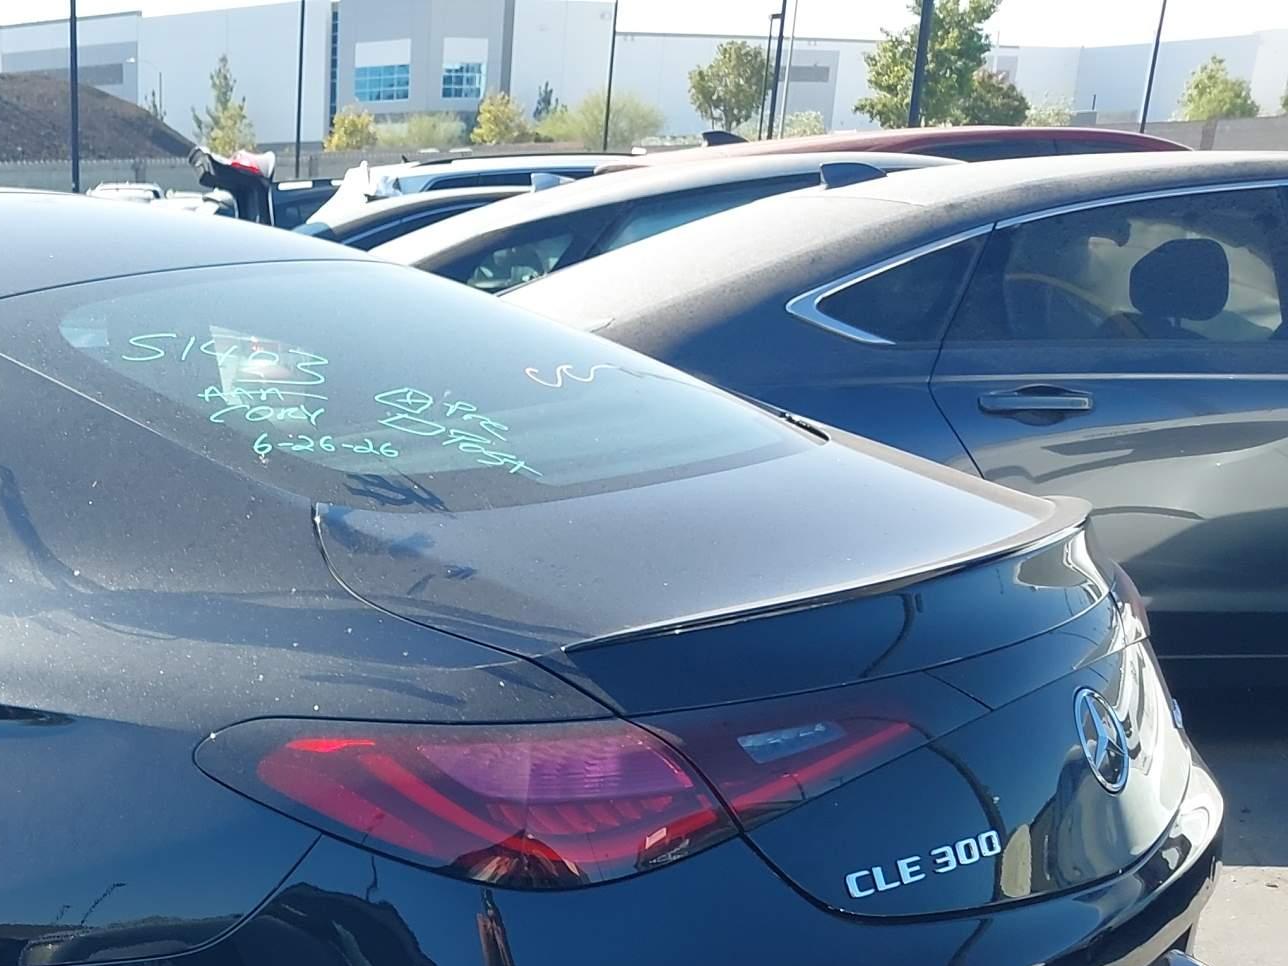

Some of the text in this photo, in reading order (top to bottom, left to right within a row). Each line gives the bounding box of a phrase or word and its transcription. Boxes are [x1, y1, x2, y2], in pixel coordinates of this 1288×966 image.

[252, 432, 399, 458] 6-26-26
[845, 829, 1002, 899] CLE 300
